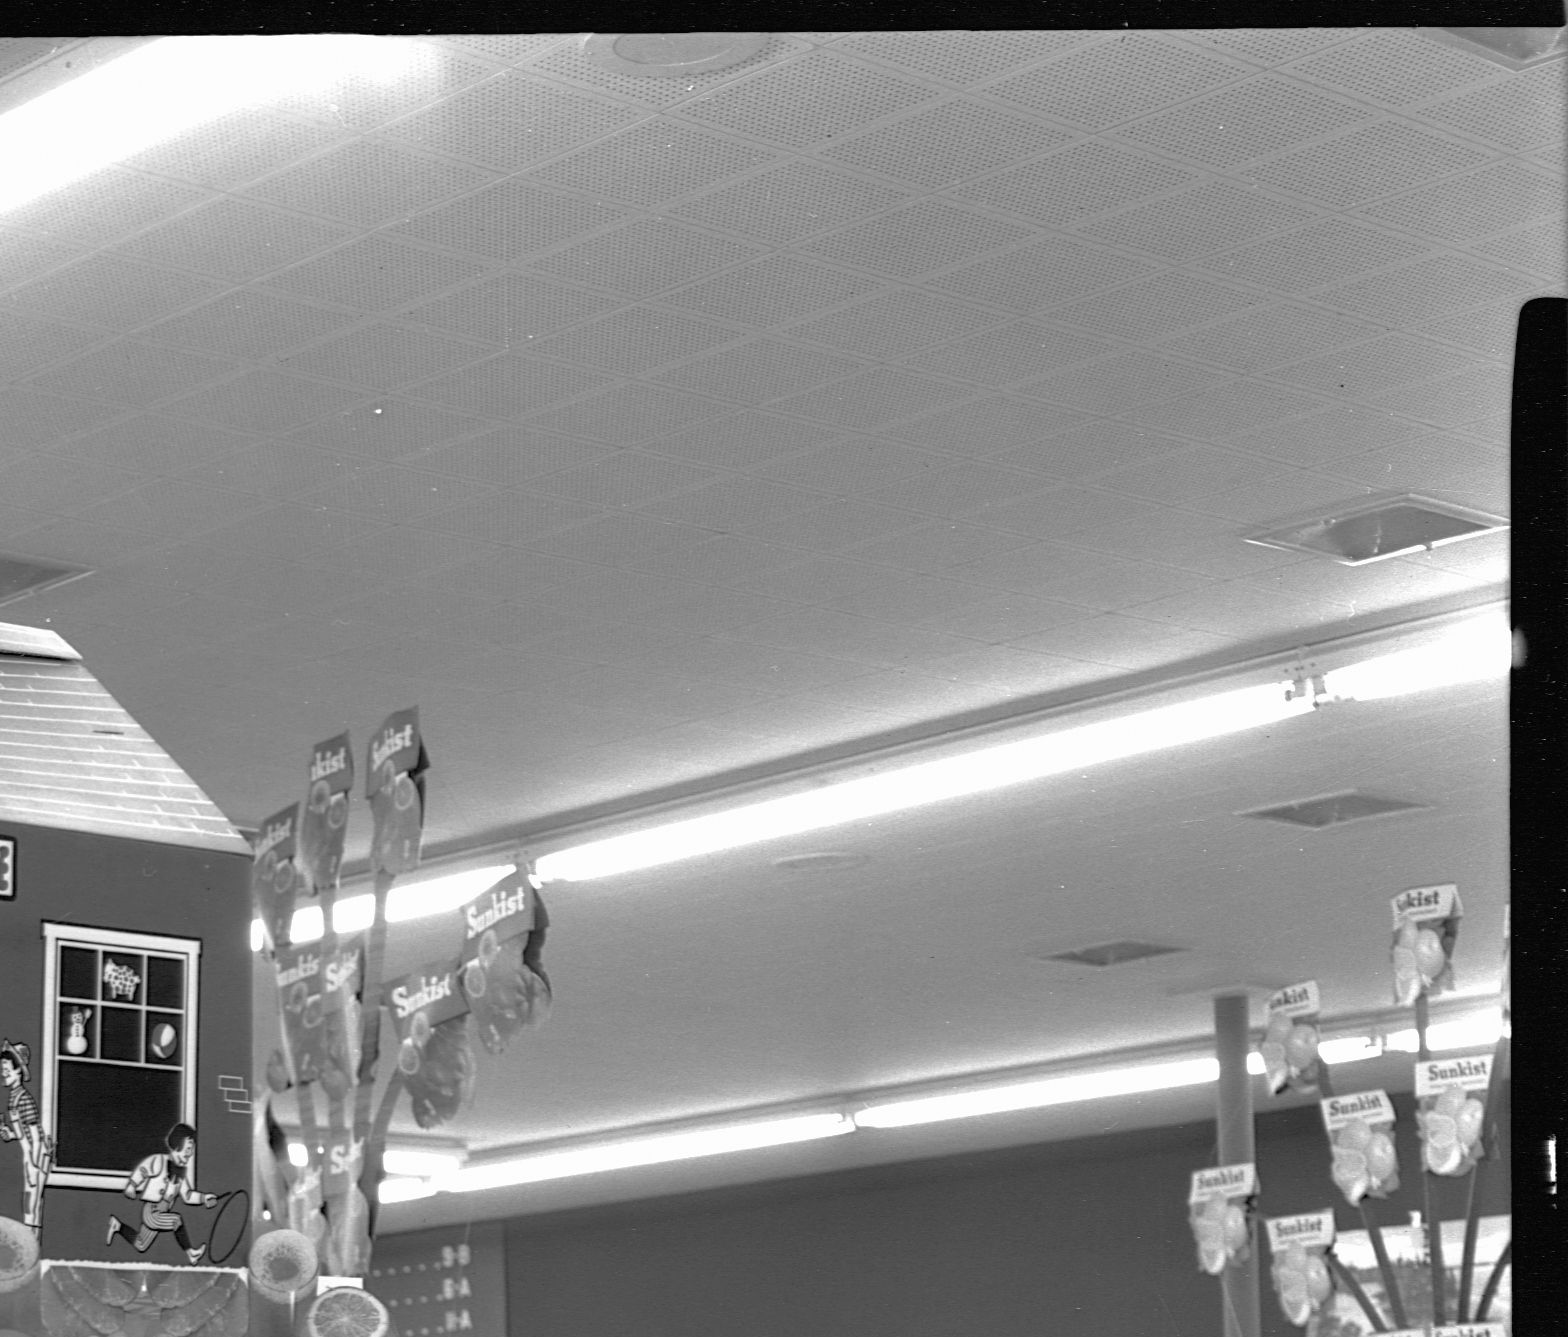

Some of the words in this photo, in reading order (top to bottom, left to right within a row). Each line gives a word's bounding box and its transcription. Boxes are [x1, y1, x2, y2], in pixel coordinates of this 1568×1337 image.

[466, 886, 526, 939] Sunkist
[392, 972, 452, 1019] Sunkist
[1428, 1060, 1488, 1082] Sunkist
[1329, 1094, 1383, 1117] Sunkist
[1197, 1168, 1246, 1190] Sunkist
[1275, 1216, 1323, 1238] Sunkist
